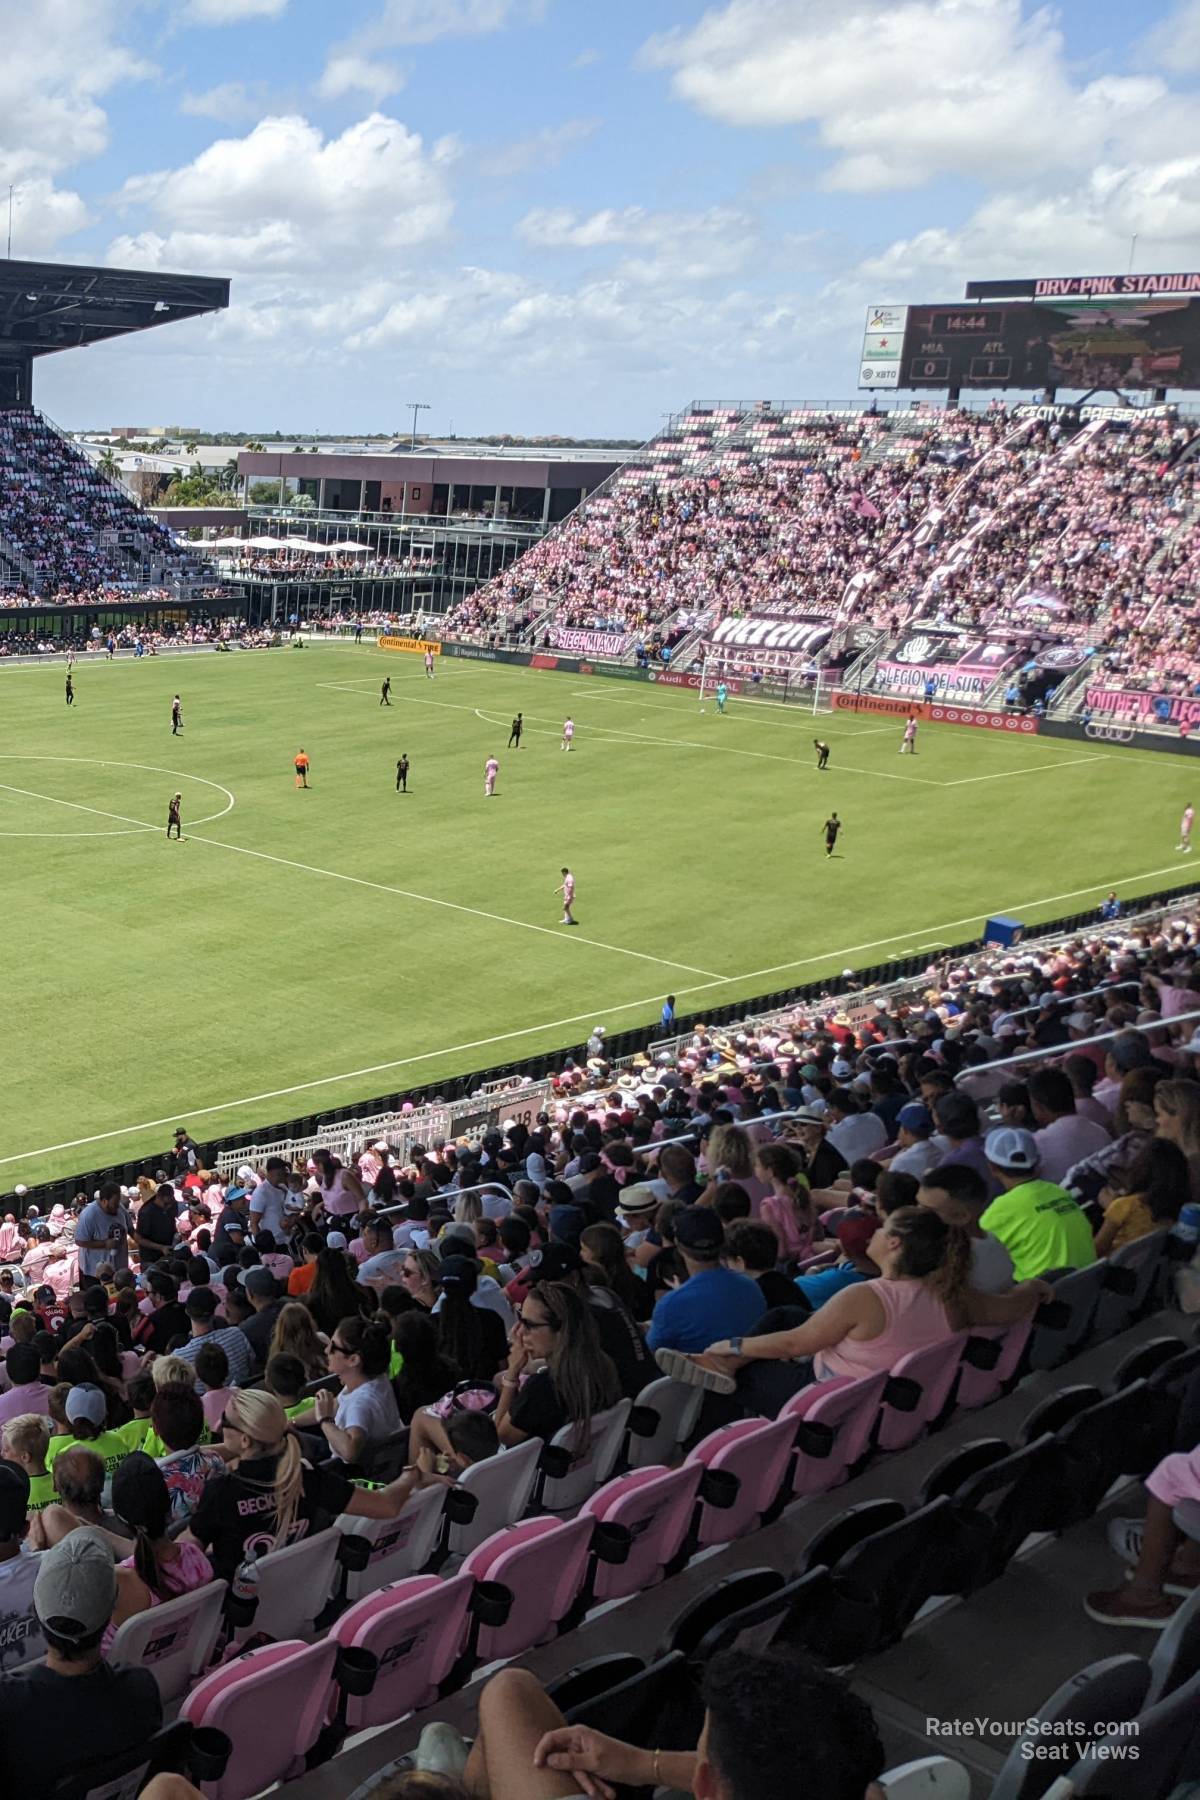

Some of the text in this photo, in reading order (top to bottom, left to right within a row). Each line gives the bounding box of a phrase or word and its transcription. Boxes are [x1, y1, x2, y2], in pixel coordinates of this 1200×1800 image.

[1035, 279, 1073, 295] DRV
[1079, 277, 1117, 294] PNK
[947, 317, 986, 330] 14:44
[921, 342, 1005, 354] MIA ATL
[875, 369, 897, 379] XBTO
[924, 361, 995, 376] 0 1
[712, 617, 779, 644] VICE
[763, 621, 833, 650] CITY
[380, 636, 417, 649] Continental
[559, 631, 621, 654] SIEGE MIAMI
[658, 674, 682, 684] Audi
[886, 667, 930, 686] LEGION
[933, 673, 955, 689] DEL
[836, 694, 912, 713] Continental
